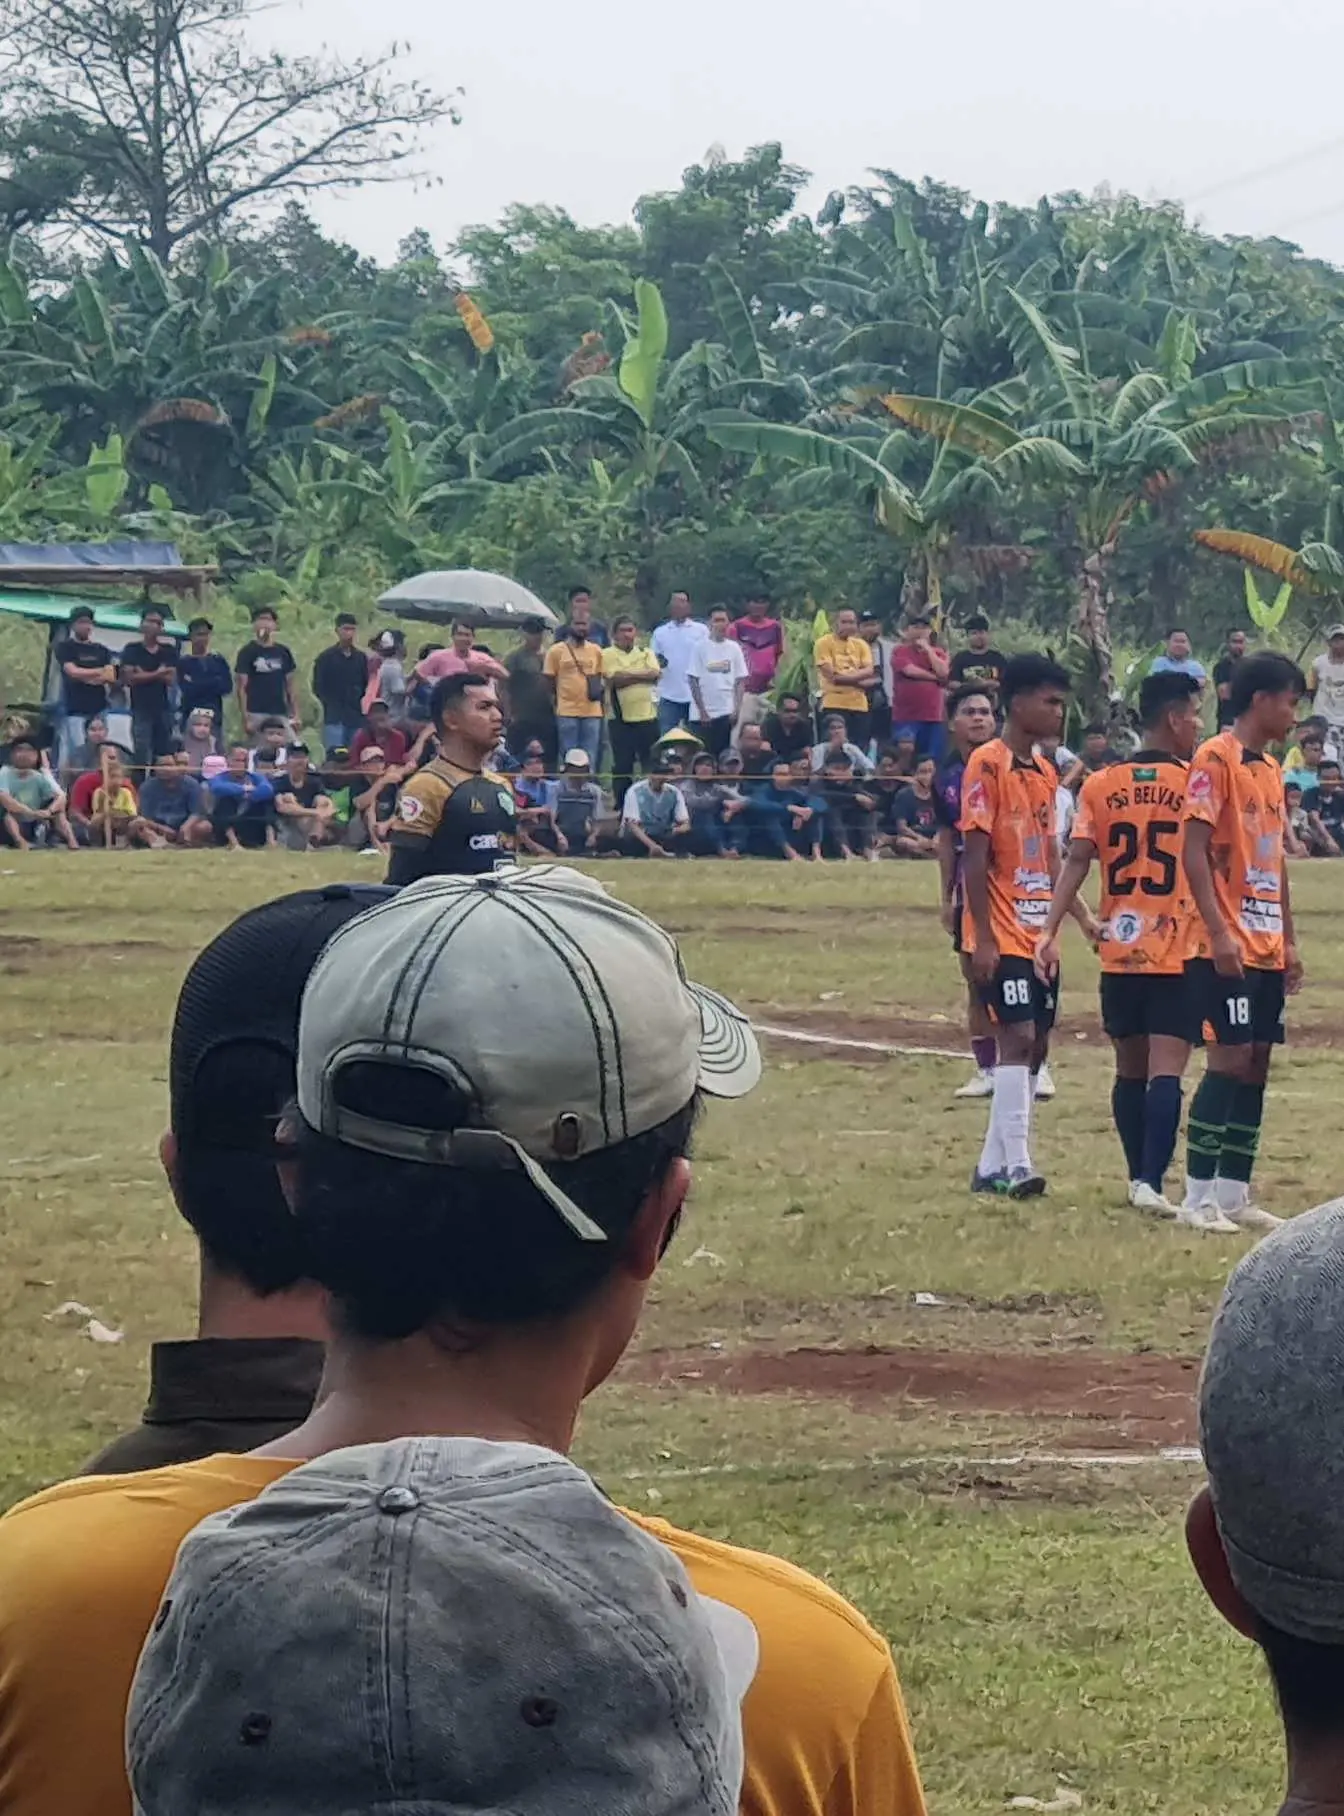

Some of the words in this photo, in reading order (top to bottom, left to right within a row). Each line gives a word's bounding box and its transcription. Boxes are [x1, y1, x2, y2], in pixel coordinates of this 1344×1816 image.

[1134, 785, 1184, 812] BELVAS
[1107, 820, 1179, 896] 25
[1003, 978, 1030, 1006] 88
[1226, 997, 1249, 1025] 18
